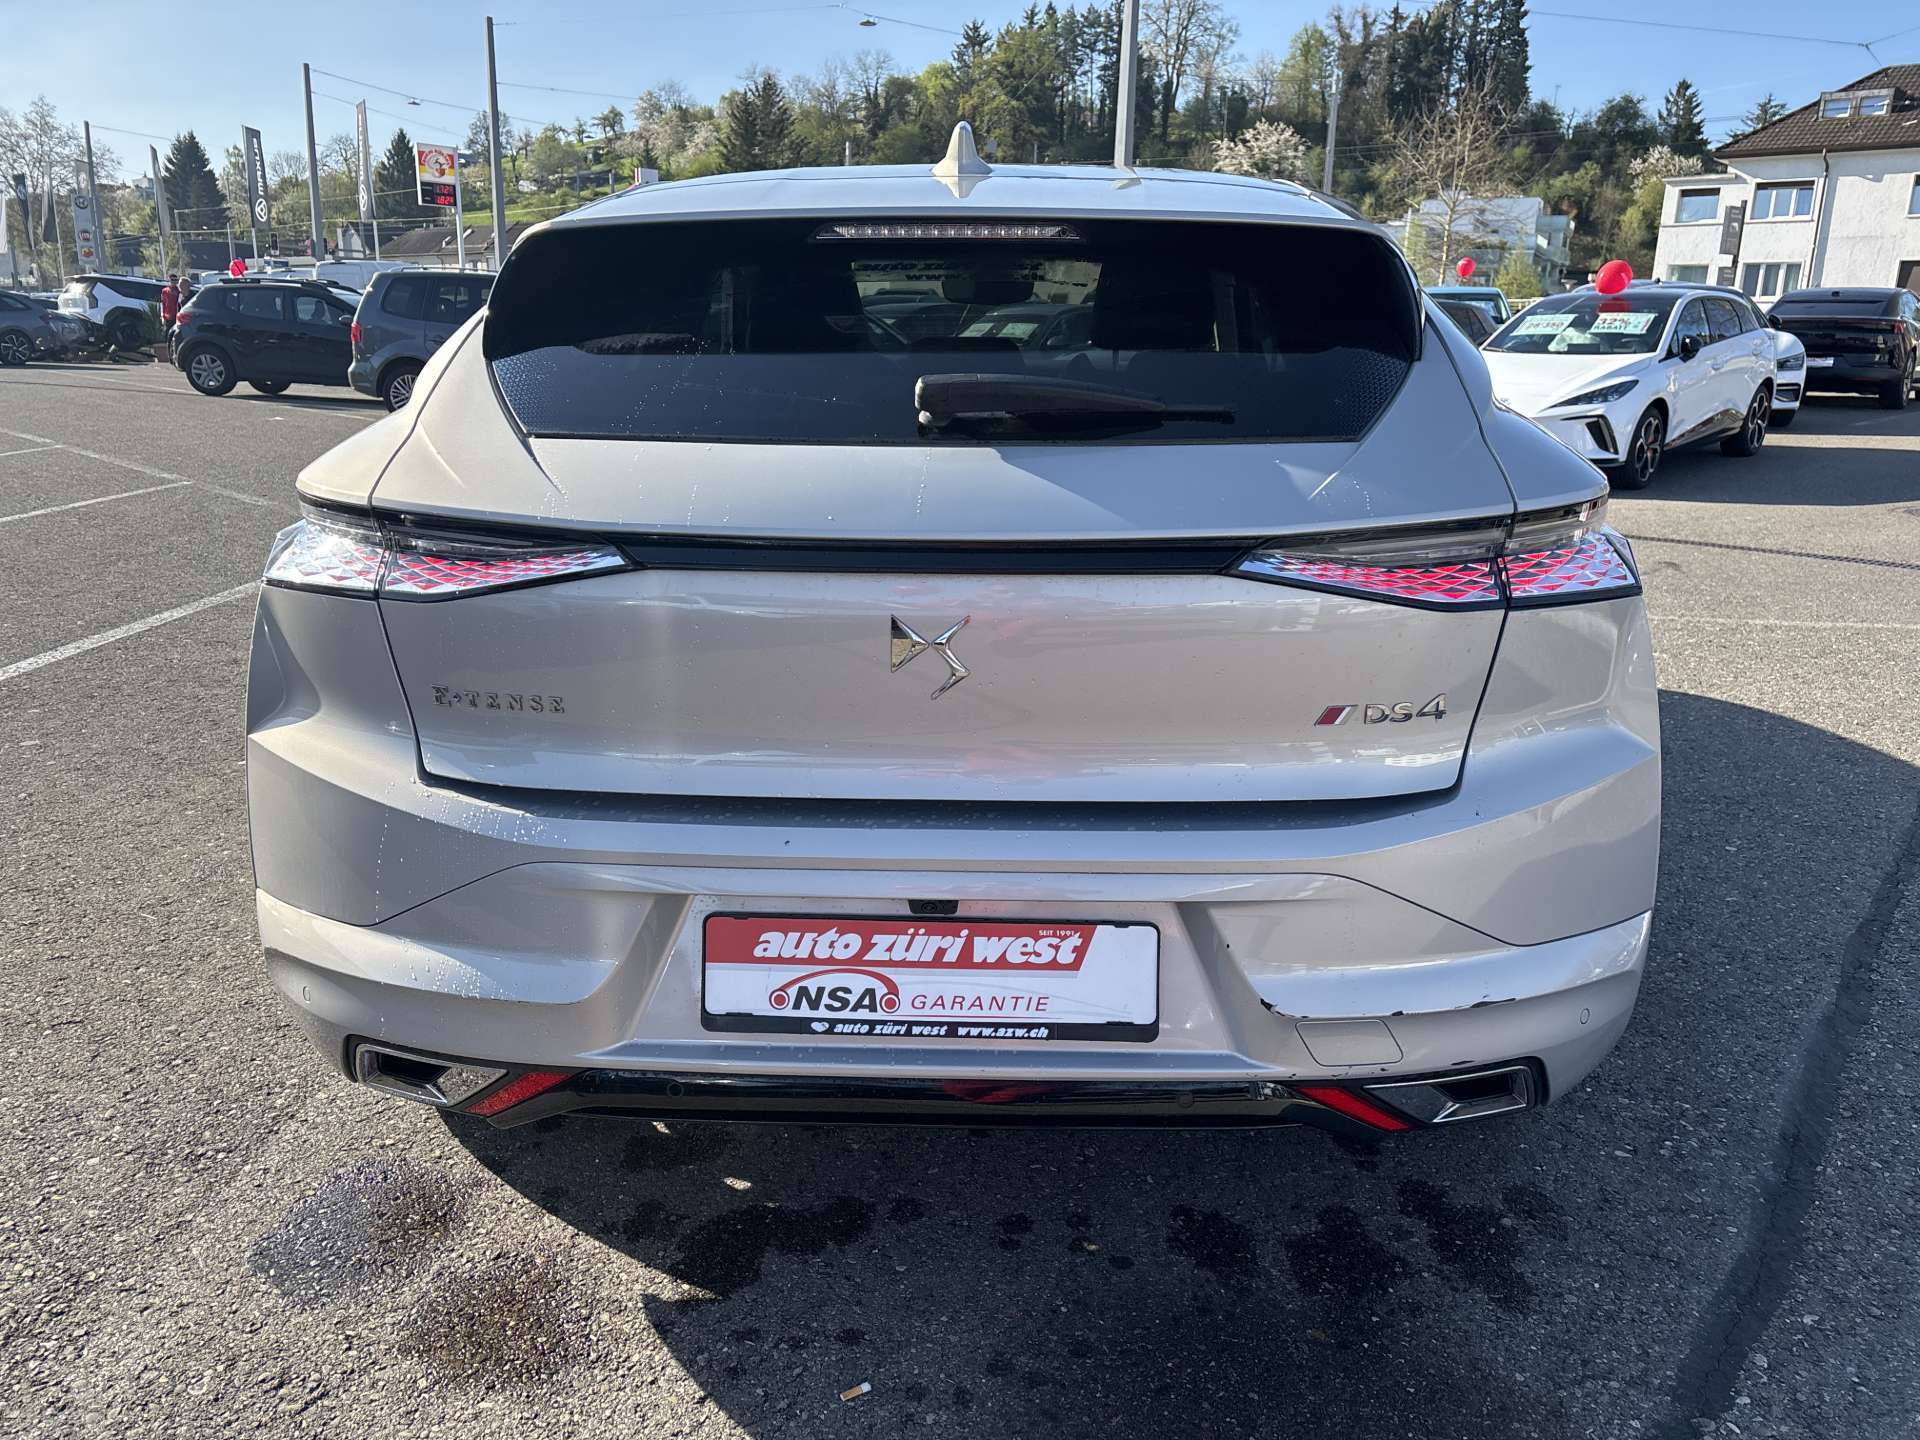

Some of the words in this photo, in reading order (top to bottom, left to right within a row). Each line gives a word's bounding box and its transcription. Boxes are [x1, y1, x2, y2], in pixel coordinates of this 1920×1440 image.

[1039, 929, 1053, 937] SEIT
[753, 927, 863, 960] auto
[862, 928, 969, 962] züri
[972, 932, 1083, 965] west
[792, 985, 878, 1013] NSA
[911, 994, 1050, 1012] GARANTIE
[834, 1023, 869, 1034] auto
[872, 1023, 908, 1035] züri
[912, 1025, 948, 1036] west
[957, 1025, 1049, 1038] www.azw.ch
